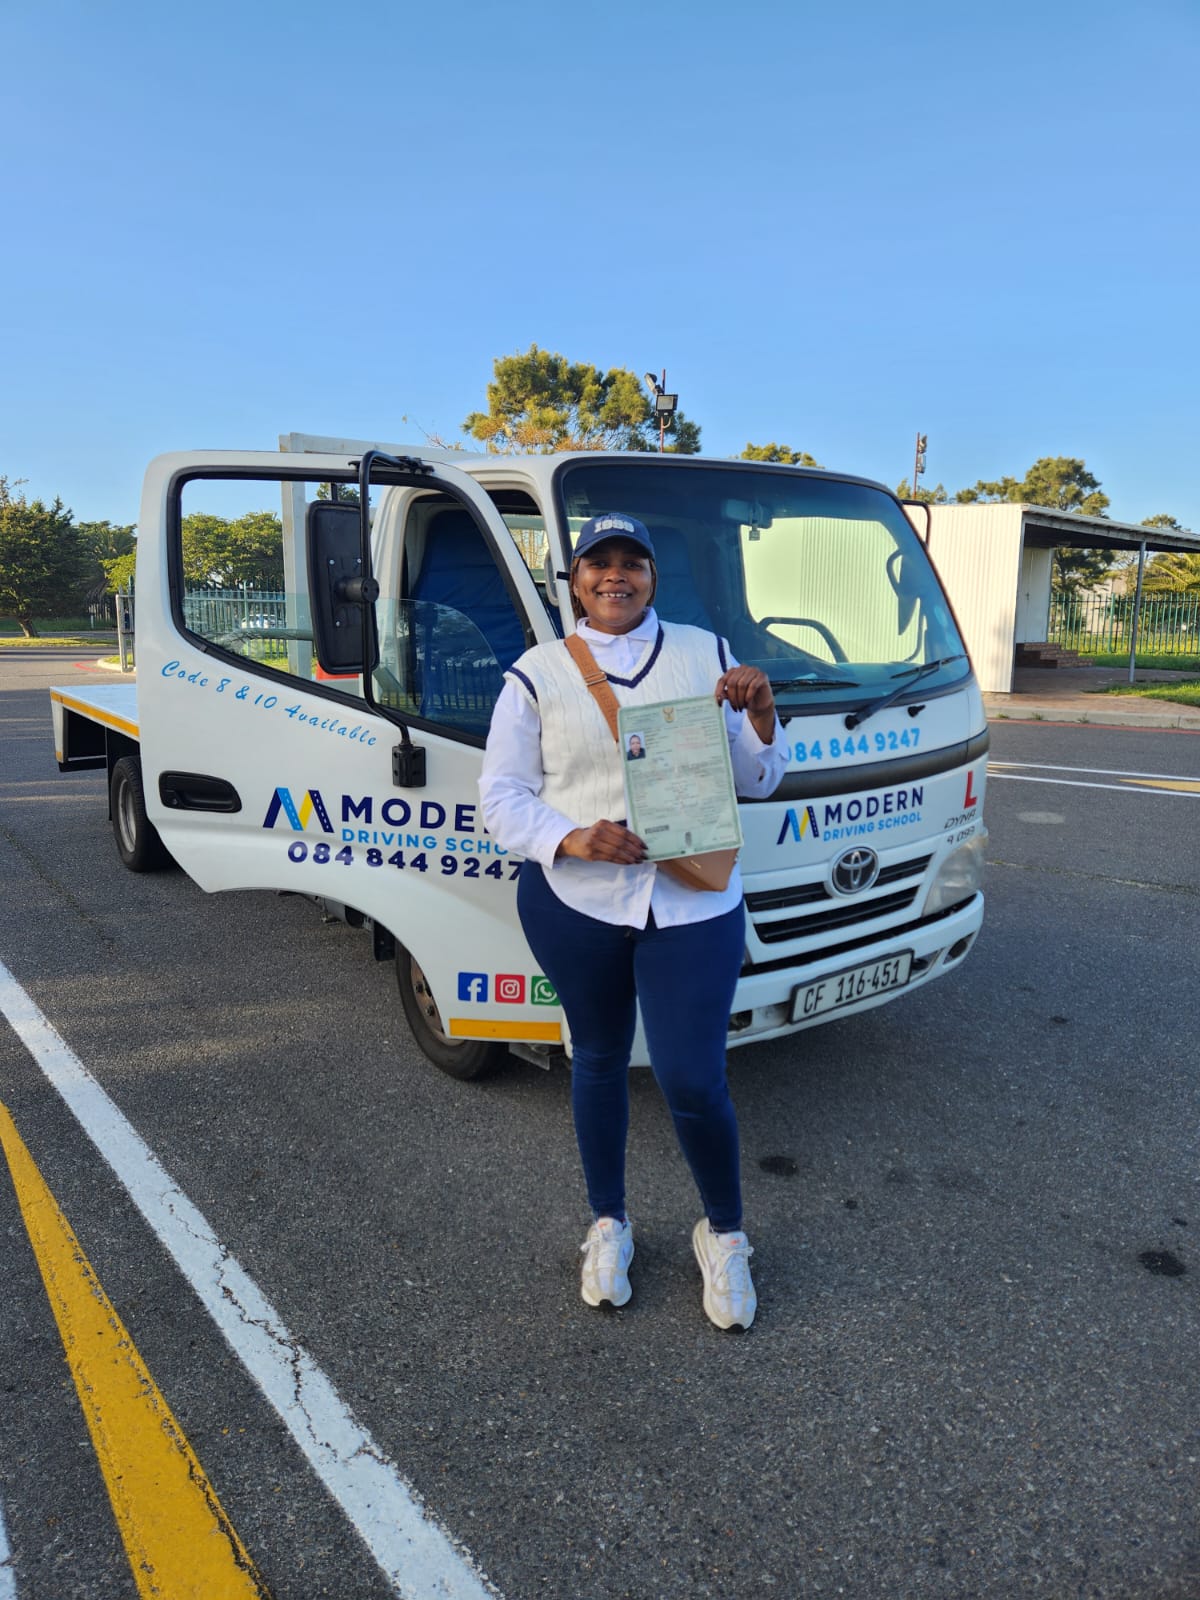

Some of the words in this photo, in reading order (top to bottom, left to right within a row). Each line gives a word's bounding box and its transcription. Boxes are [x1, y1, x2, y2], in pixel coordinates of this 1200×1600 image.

[161, 660, 208, 687] Code
[216, 678, 231, 693] 8
[235, 686, 250, 700] &
[254, 694, 278, 709] 10
[285, 705, 377, 746] Available
[788, 740, 823, 763] 84
[829, 734, 870, 759] 844
[874, 727, 921, 750] 9247
[824, 785, 925, 827] MODERN
[964, 770, 977, 809] L
[341, 795, 490, 835] MODE
[823, 819, 875, 842] DRIVING
[877, 811, 923, 831] SCHOOL
[342, 829, 437, 850] DRIVING
[287, 841, 354, 866] 084
[366, 848, 428, 873] 844
[440, 854, 524, 881] 9247
[803, 983, 826, 1014] CF
[835, 959, 900, 1004] 116-451
